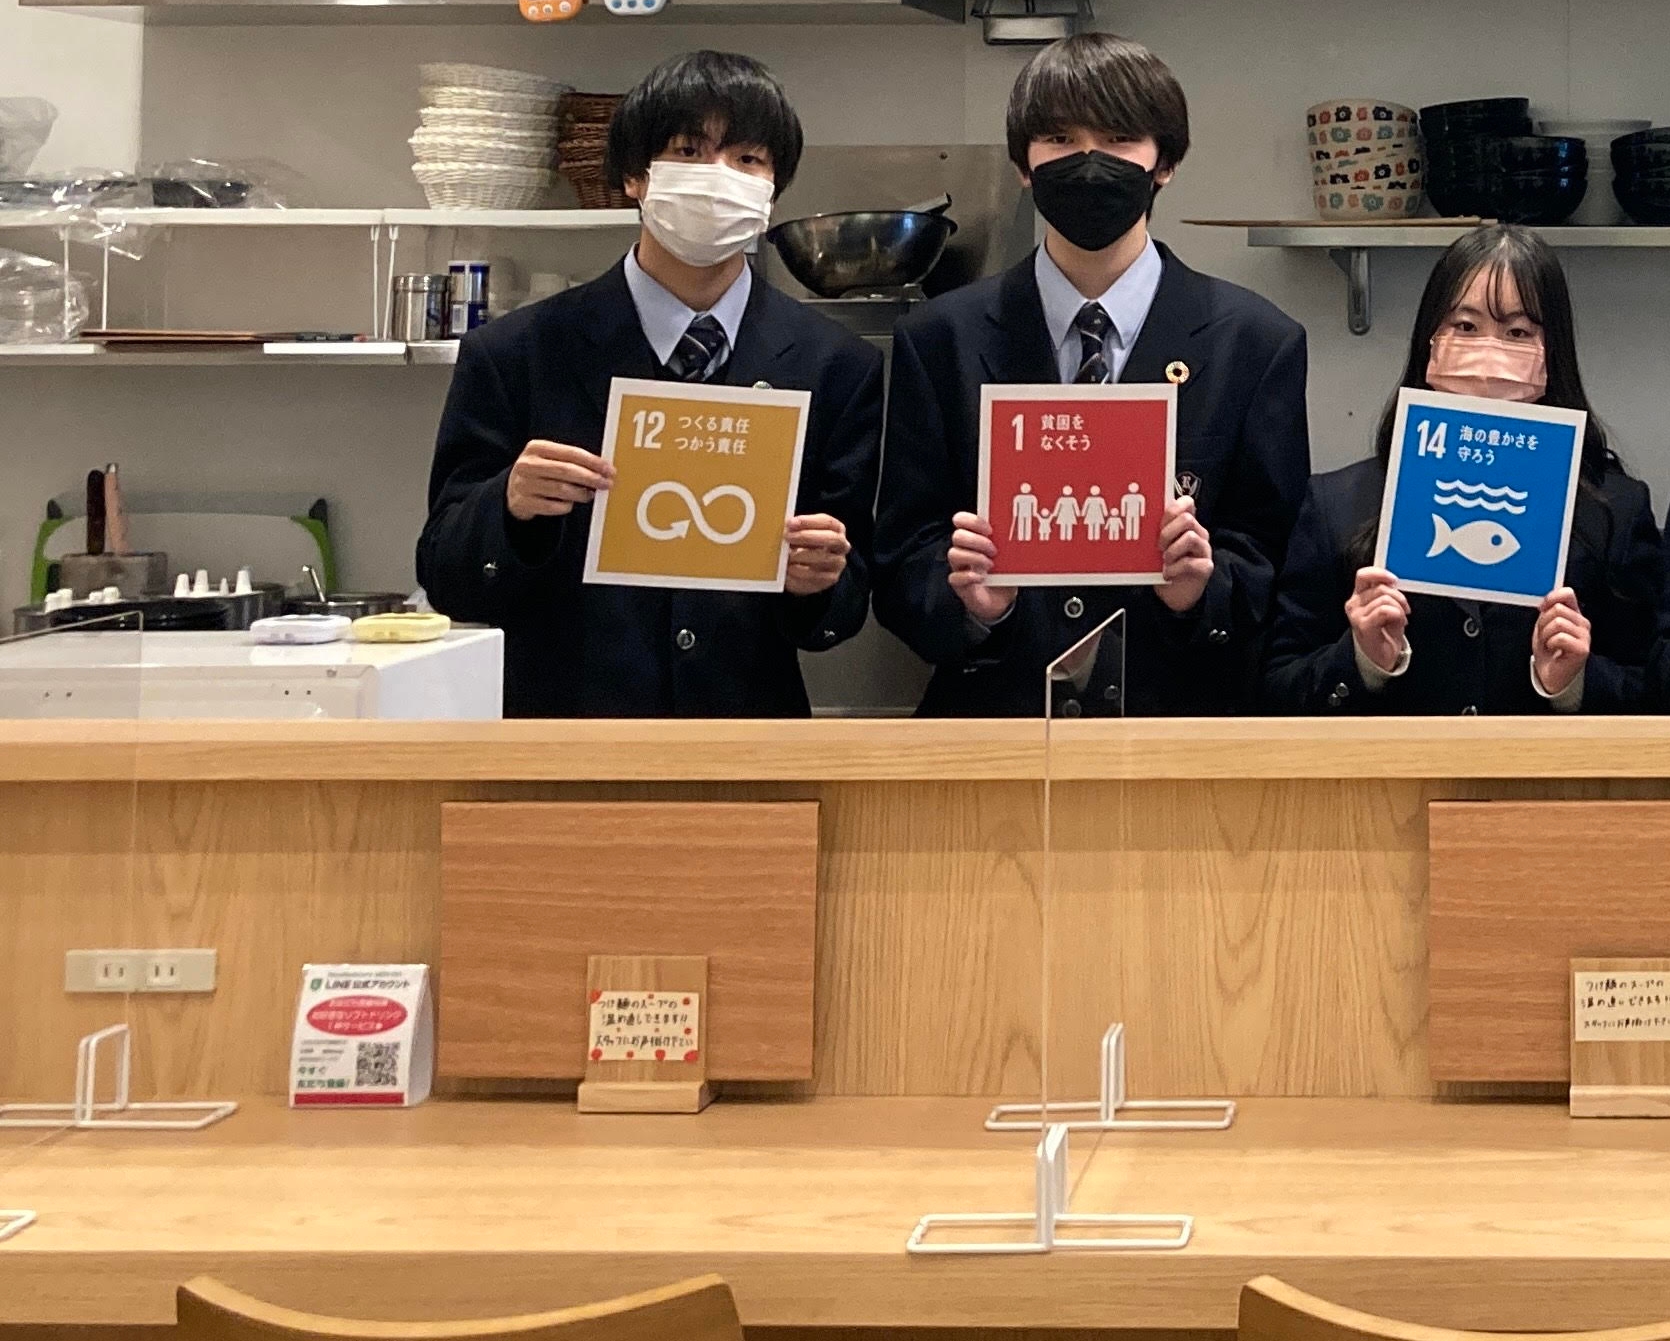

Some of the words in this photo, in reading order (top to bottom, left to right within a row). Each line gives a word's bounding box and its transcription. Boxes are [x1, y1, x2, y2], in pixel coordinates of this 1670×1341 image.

[632, 409, 666, 450] 12
[679, 415, 751, 434] つくる責任
[1011, 413, 1025, 451] 1
[1040, 413, 1085, 431] 貧困を
[675, 436, 747, 455] つかう責任
[1040, 434, 1091, 451] なくそう
[1416, 419, 1448, 459] 14
[1459, 424, 1539, 450] 海の豊かさを
[1457, 445, 1495, 466] 守ろう
